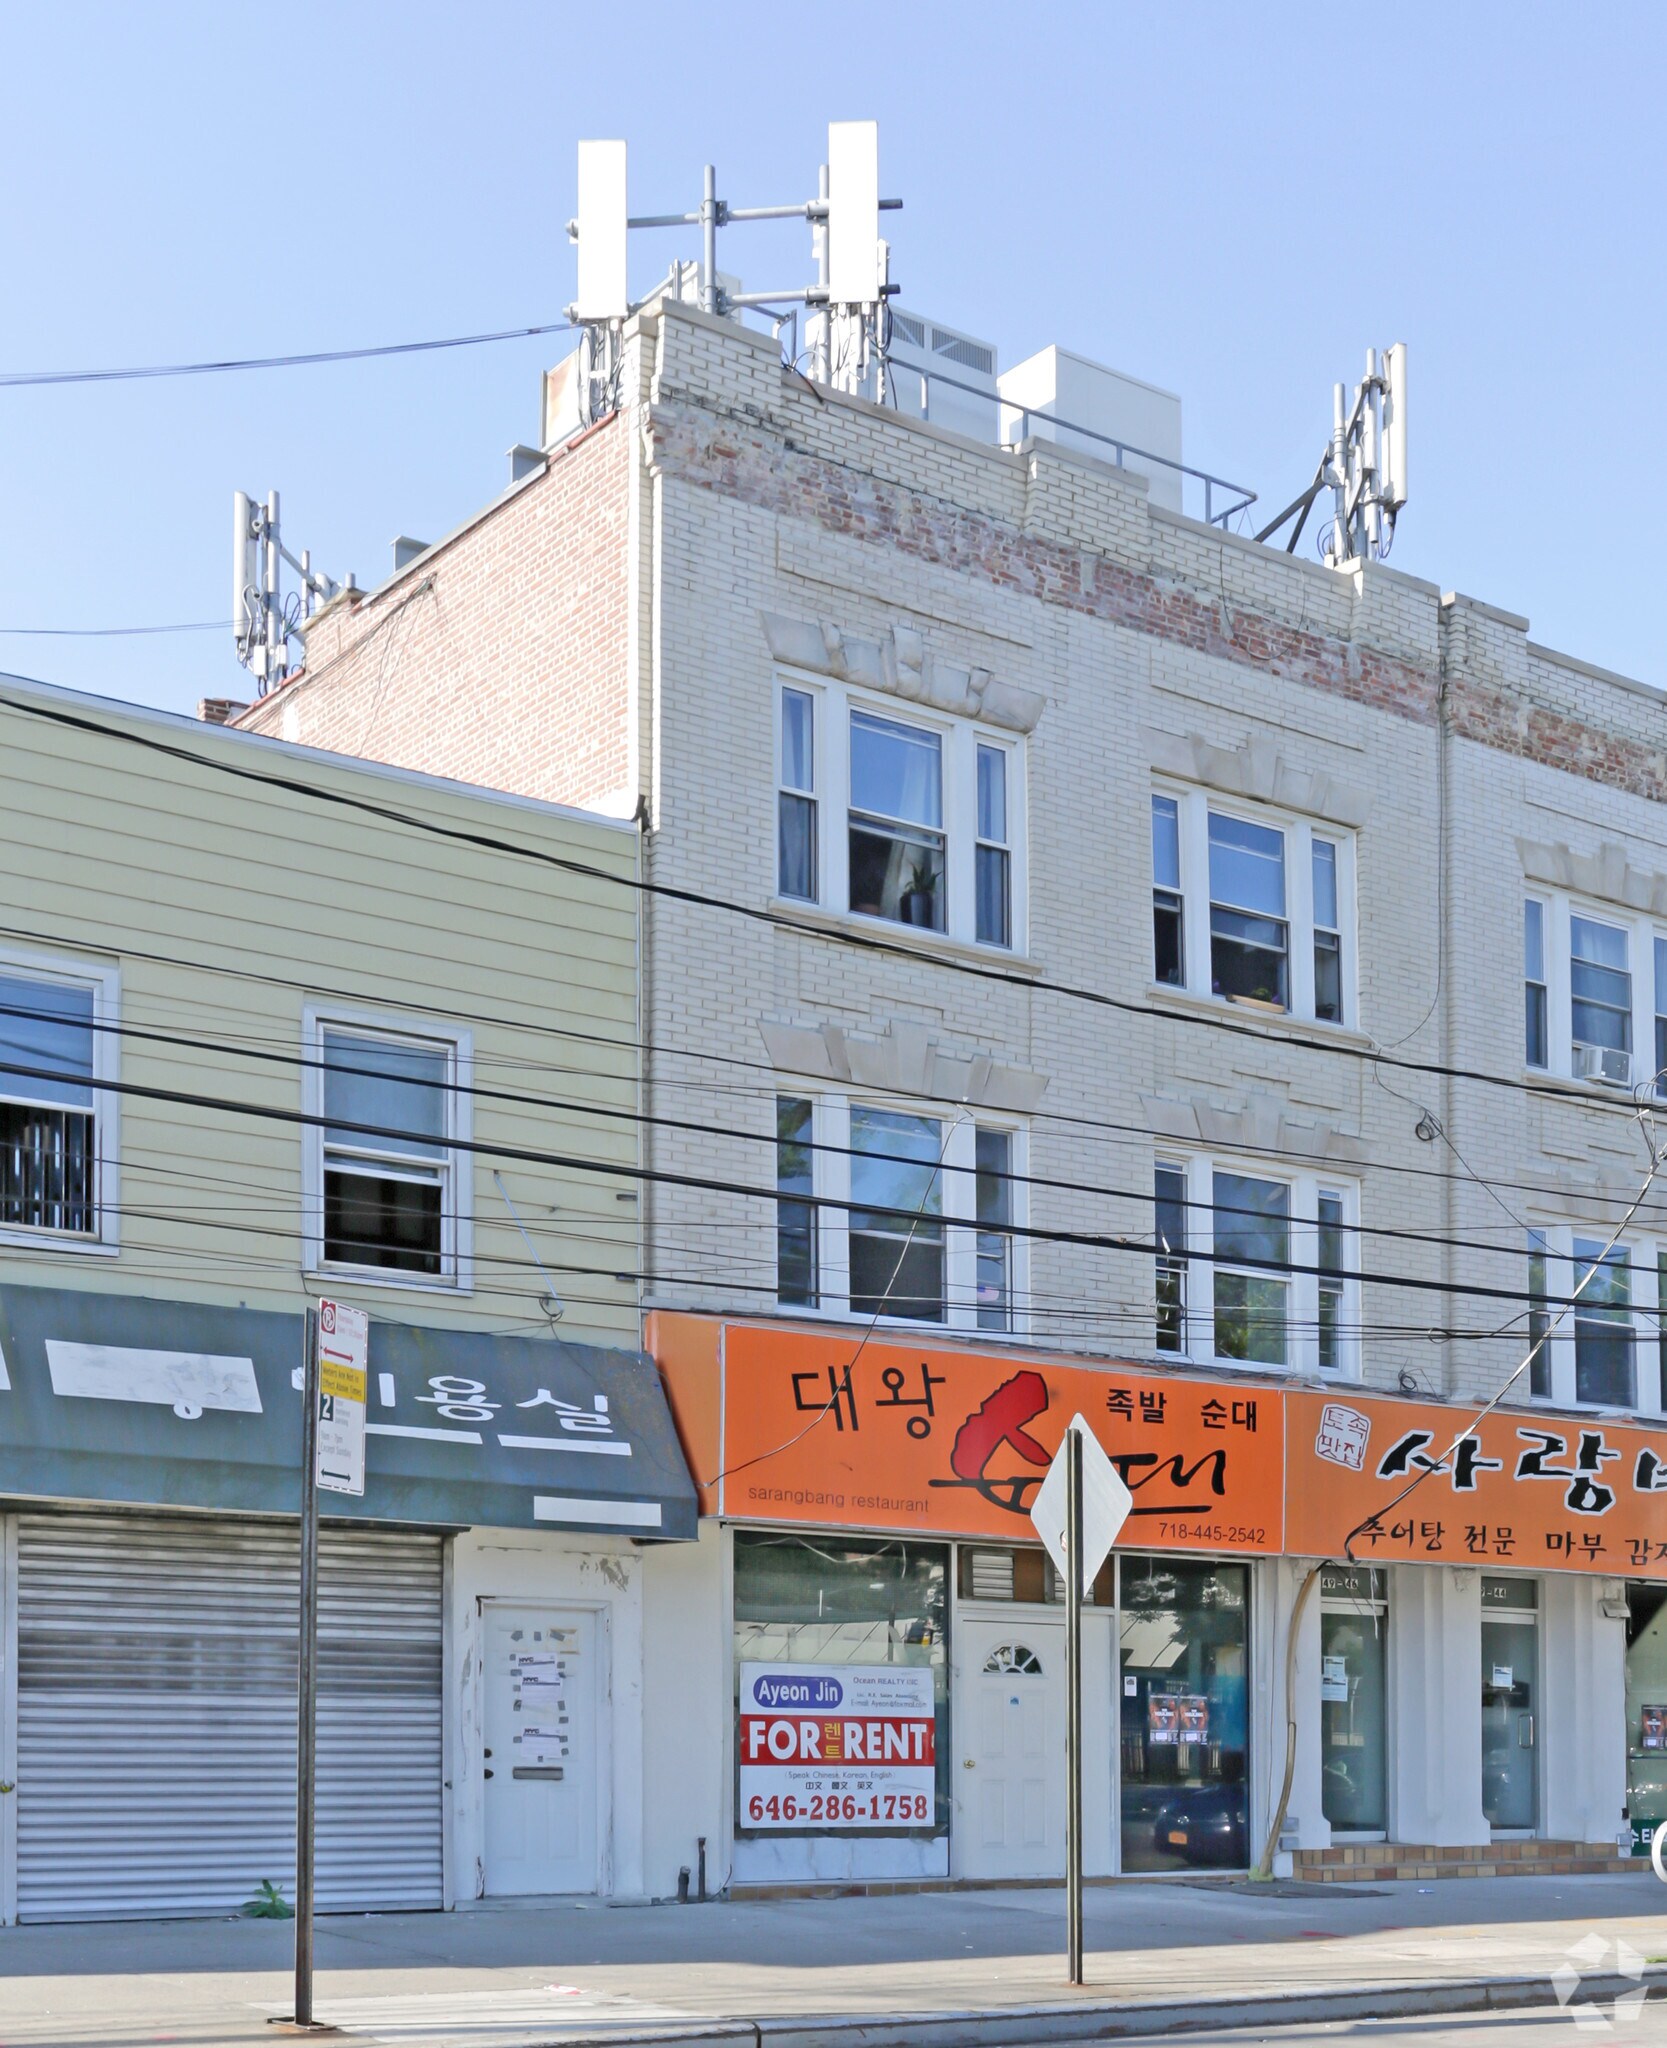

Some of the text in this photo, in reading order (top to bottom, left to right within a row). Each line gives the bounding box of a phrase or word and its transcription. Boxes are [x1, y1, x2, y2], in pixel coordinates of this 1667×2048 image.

[322, 1394, 331, 1418] 2
[791, 1363, 946, 1440] 대왕
[1106, 1388, 1257, 1432] 족발 순대
[748, 1487, 929, 1512] sarangbang restaurant
[1158, 1523, 1266, 1544] 718-445-2542
[758, 1680, 838, 1706] Ayeon Jin
[852, 1676, 876, 1684] Ocean
[877, 1677, 905, 1685] REALTY
[749, 1720, 927, 1760] FOR RENT
[824, 1722, 842, 1759] 렌트
[805, 1781, 822, 1790] 中文
[749, 1795, 928, 1821] 646-286-1758
